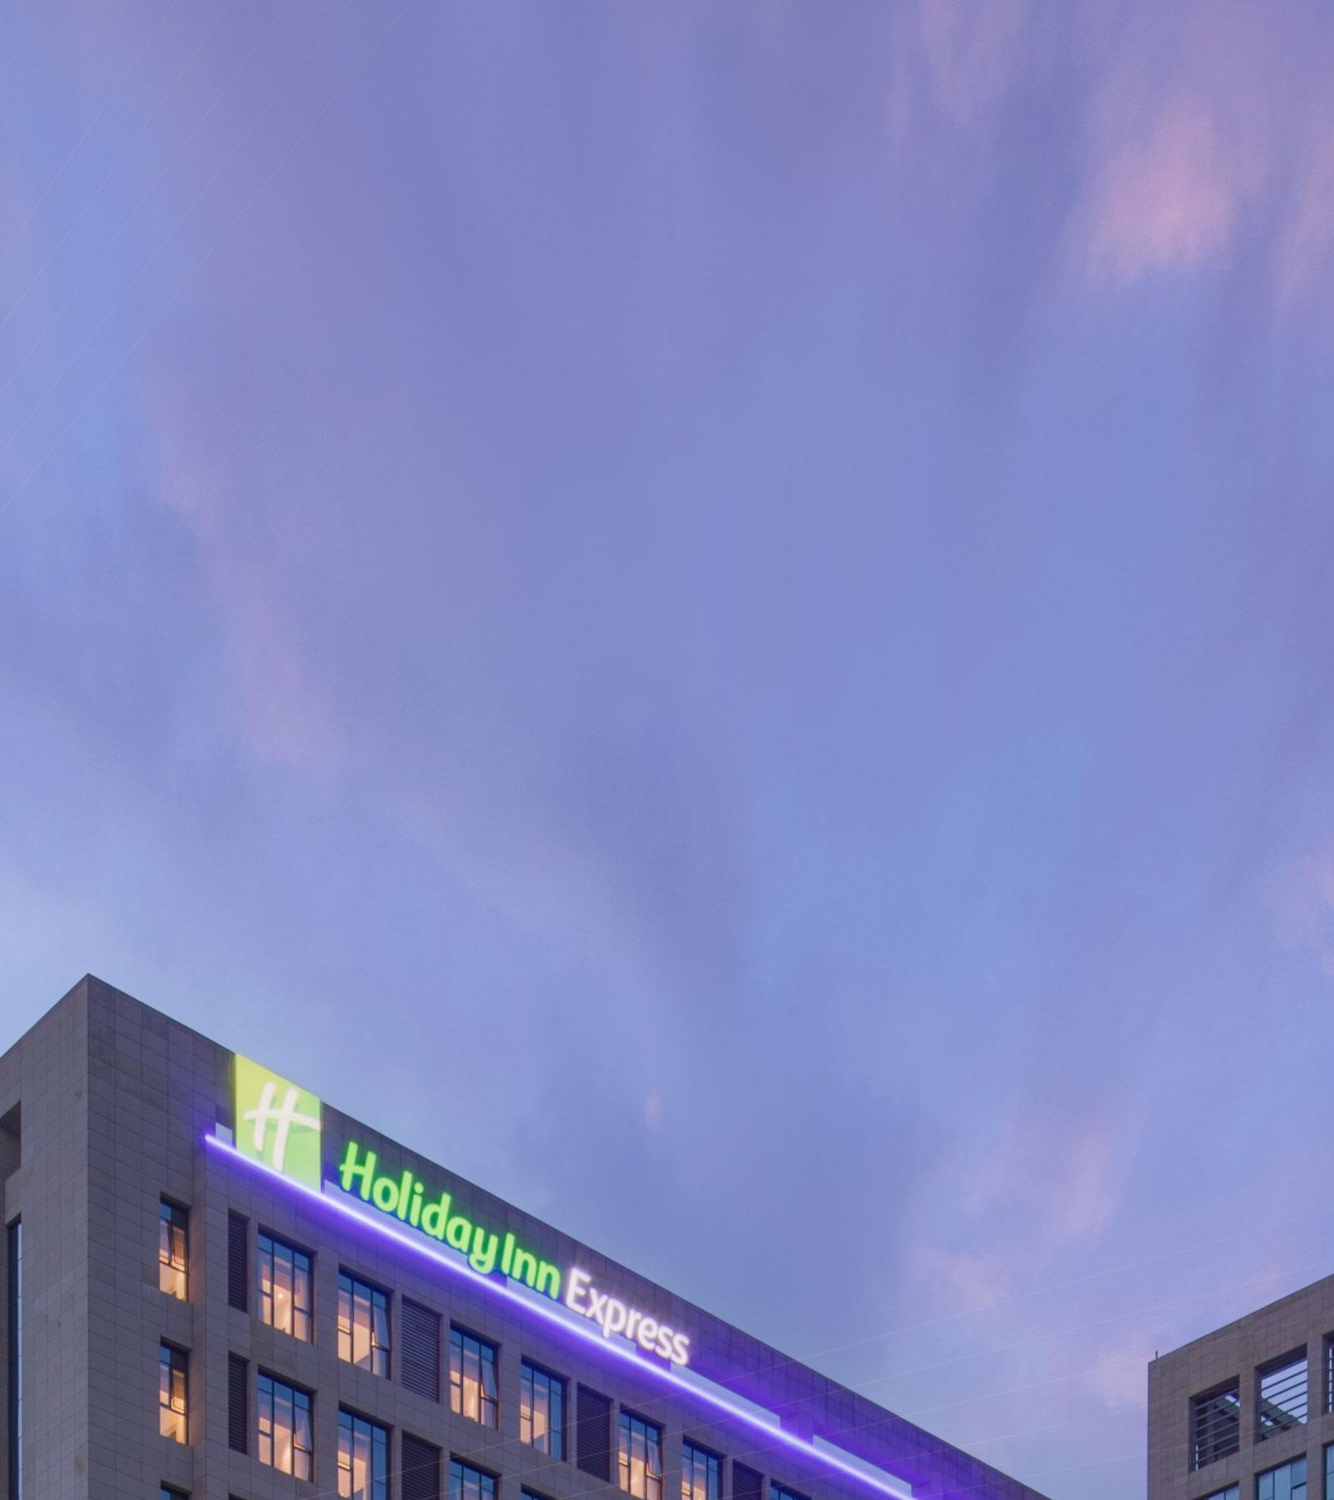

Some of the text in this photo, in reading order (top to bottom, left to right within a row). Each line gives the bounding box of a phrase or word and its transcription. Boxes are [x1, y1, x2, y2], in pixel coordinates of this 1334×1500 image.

[339, 1140, 691, 1368] Holiday Inn Express
